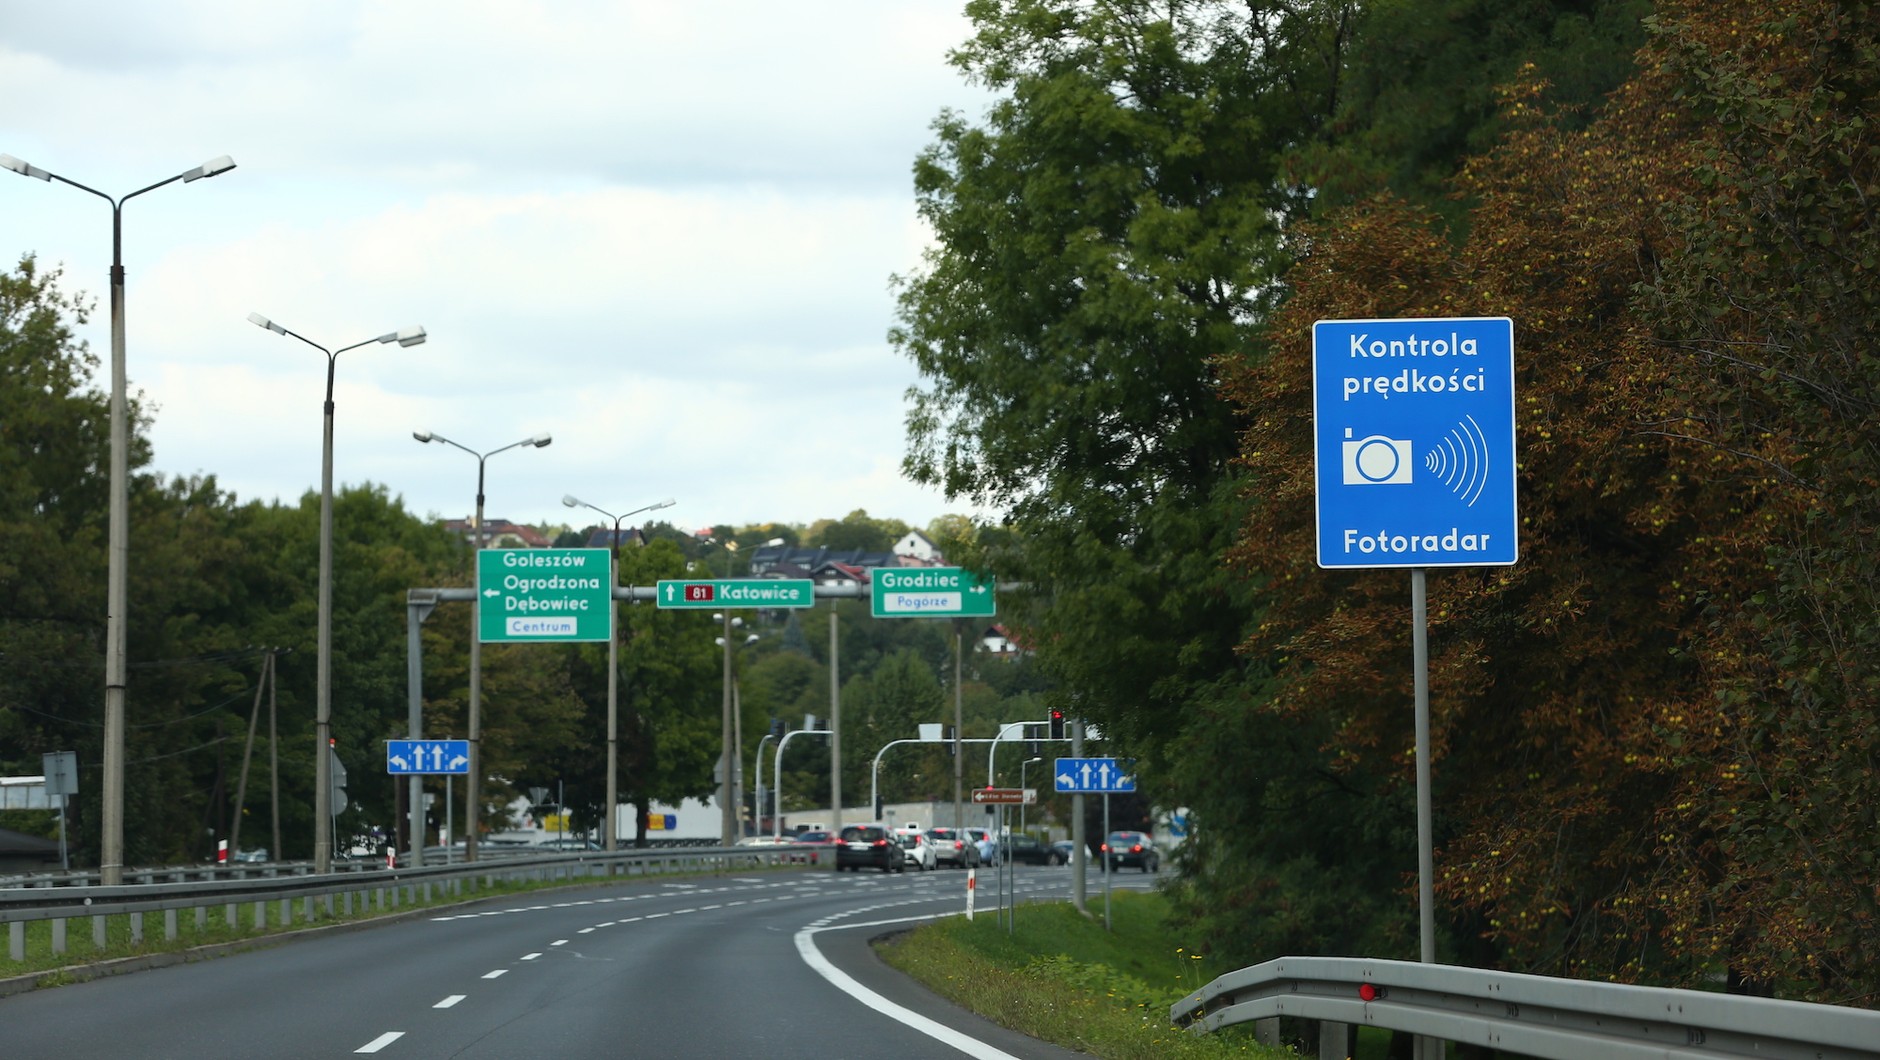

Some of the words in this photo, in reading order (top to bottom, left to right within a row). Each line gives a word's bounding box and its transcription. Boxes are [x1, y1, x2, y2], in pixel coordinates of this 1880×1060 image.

[1350, 332, 1478, 358] Kontrola
[1343, 368, 1485, 401] prędkości
[1344, 527, 1490, 553] Fotoradar
[503, 551, 586, 567] Goleszów
[504, 575, 600, 593] Ogrodzona
[881, 572, 959, 588] Grodziec
[693, 586, 707, 599] 81
[720, 584, 800, 600] Katowice
[505, 596, 589, 613] Dębowiec
[897, 594, 949, 608] Pogórze
[512, 620, 571, 633] Centrum
